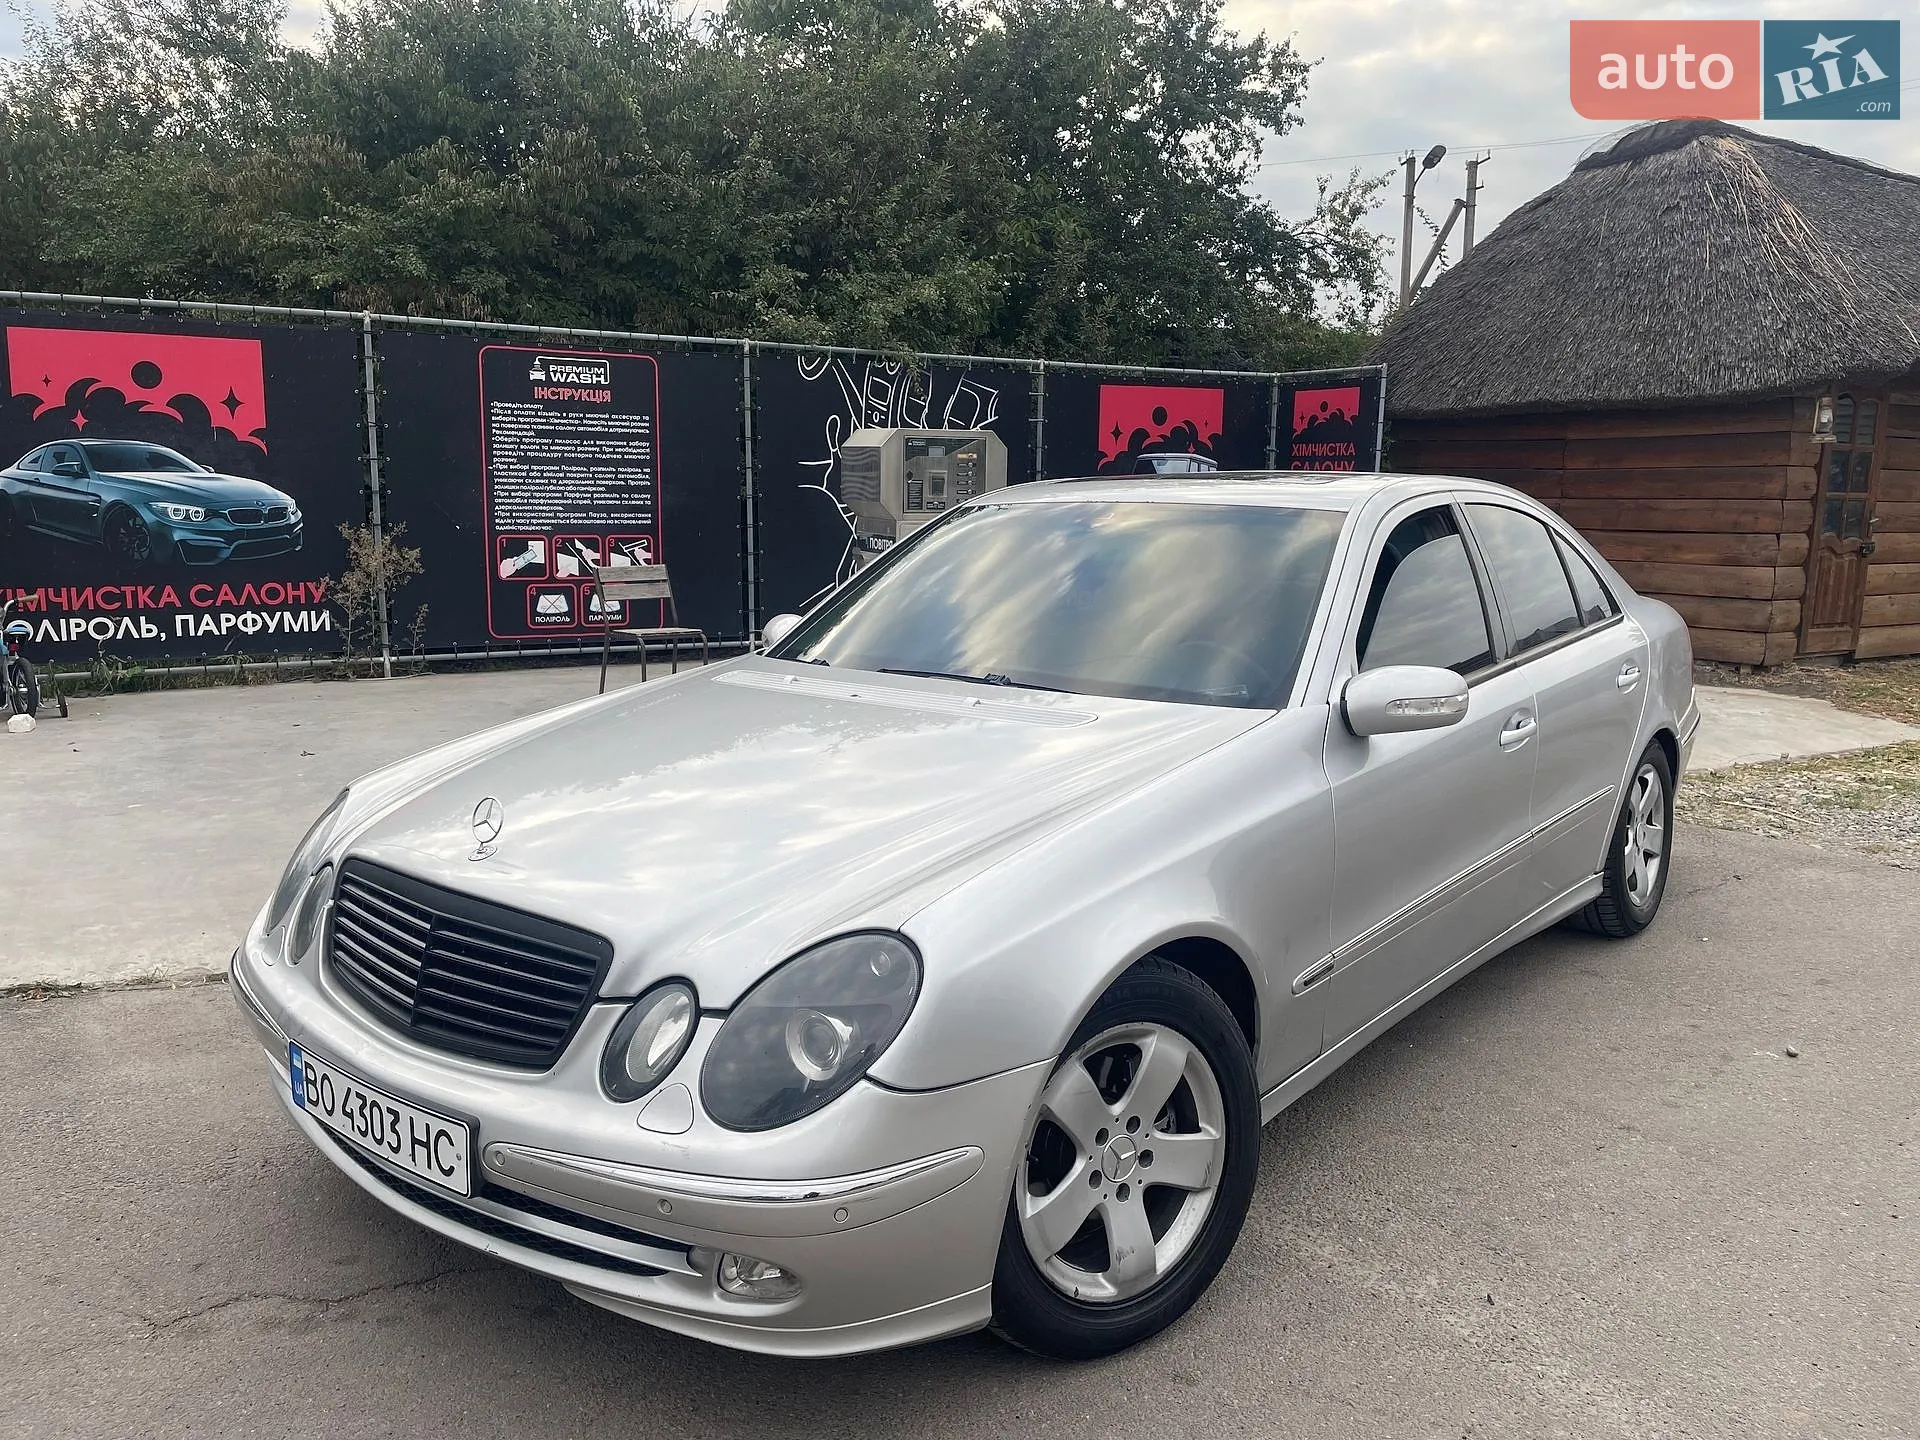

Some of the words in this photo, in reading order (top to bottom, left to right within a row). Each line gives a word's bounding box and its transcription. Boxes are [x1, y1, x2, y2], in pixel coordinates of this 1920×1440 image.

[549, 364, 605, 375] PREMIUM
[550, 372, 606, 384] WASH
[534, 386, 612, 403] ІНСТРУКЦІЯ
[1291, 442, 1356, 457] ХІМЧИСТКА
[501, 538, 507, 547] 1
[556, 538, 563, 548] 2
[609, 538, 616, 548] 3
[530, 586, 537, 596] 4
[584, 586, 591, 596] 5
[0, 584, 182, 612] ІМЧИСТКА
[189, 582, 327, 607] САЛОНУ
[535, 615, 571, 623] ПОЛІРОЛЬ
[5, 615, 167, 643] ОЛІРОЛЬ,
[175, 610, 331, 637] ПАРФУМИ
[294, 1082, 304, 1097] UA
[341, 1087, 402, 1155] 4303
